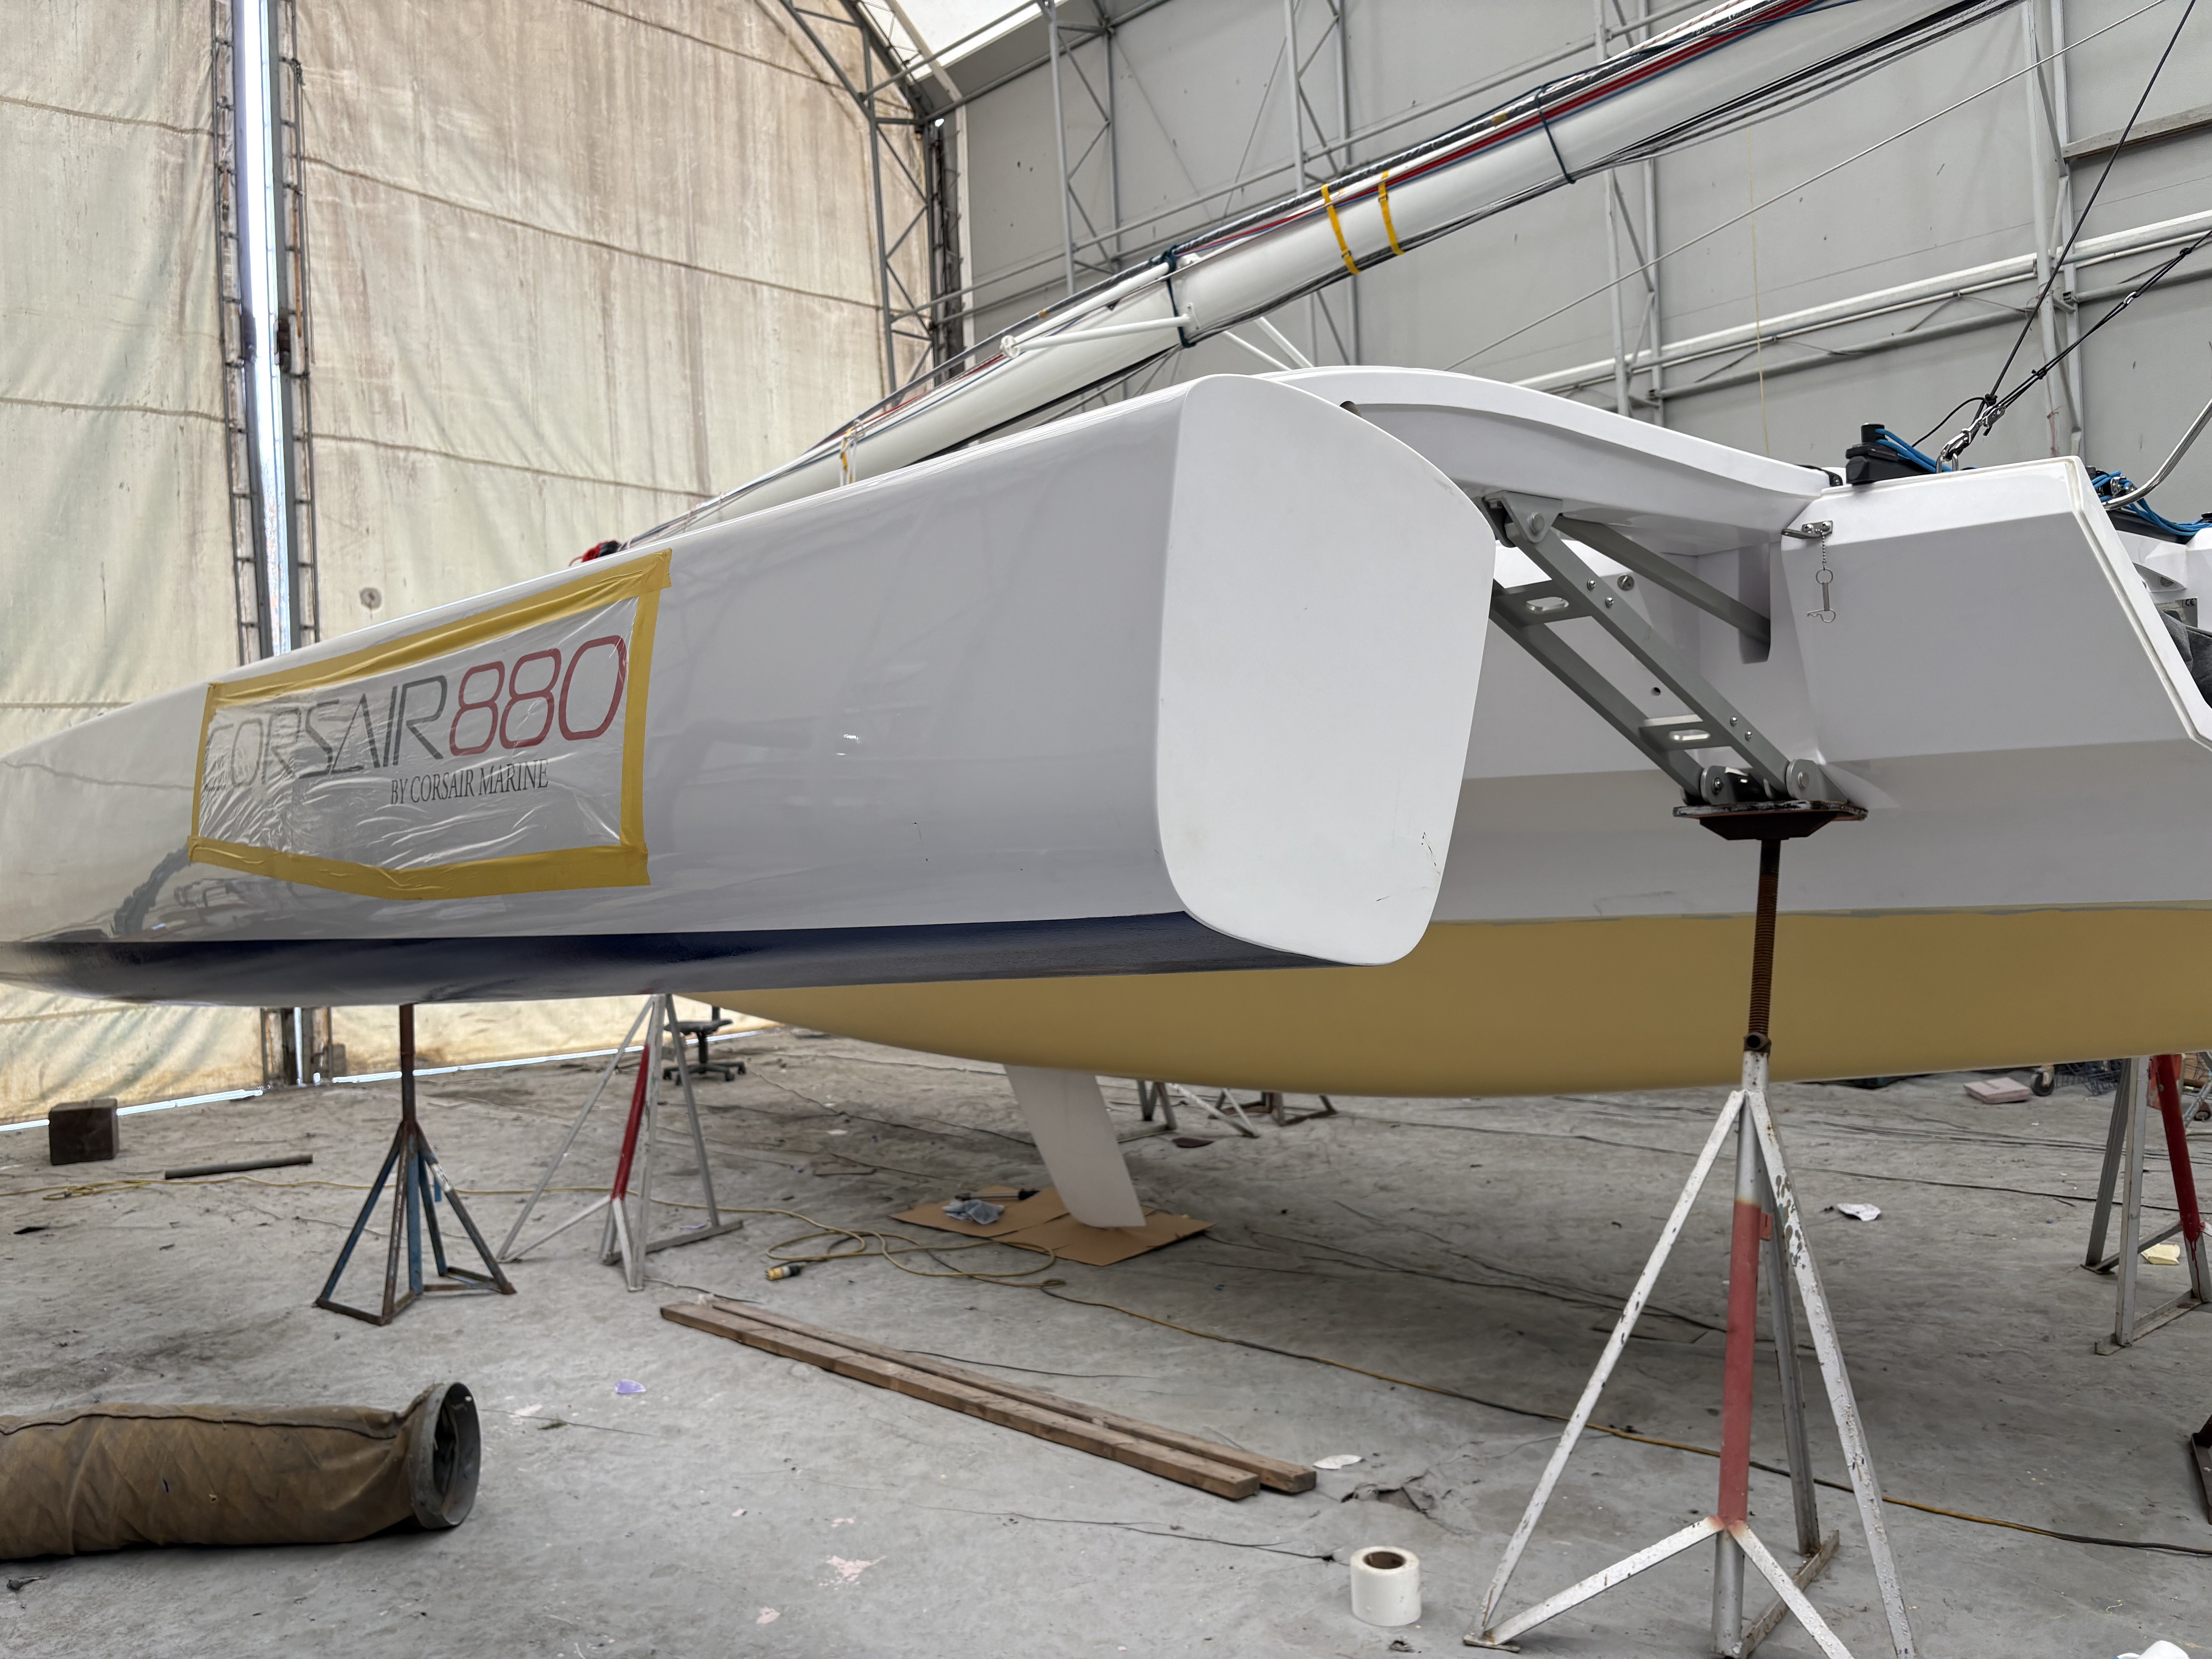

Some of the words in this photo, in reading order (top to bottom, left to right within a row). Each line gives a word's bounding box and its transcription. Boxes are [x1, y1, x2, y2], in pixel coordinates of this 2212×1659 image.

[391, 778, 408, 804] BY
[410, 769, 475, 803] CORSAIR
[478, 758, 548, 795] MARINE
